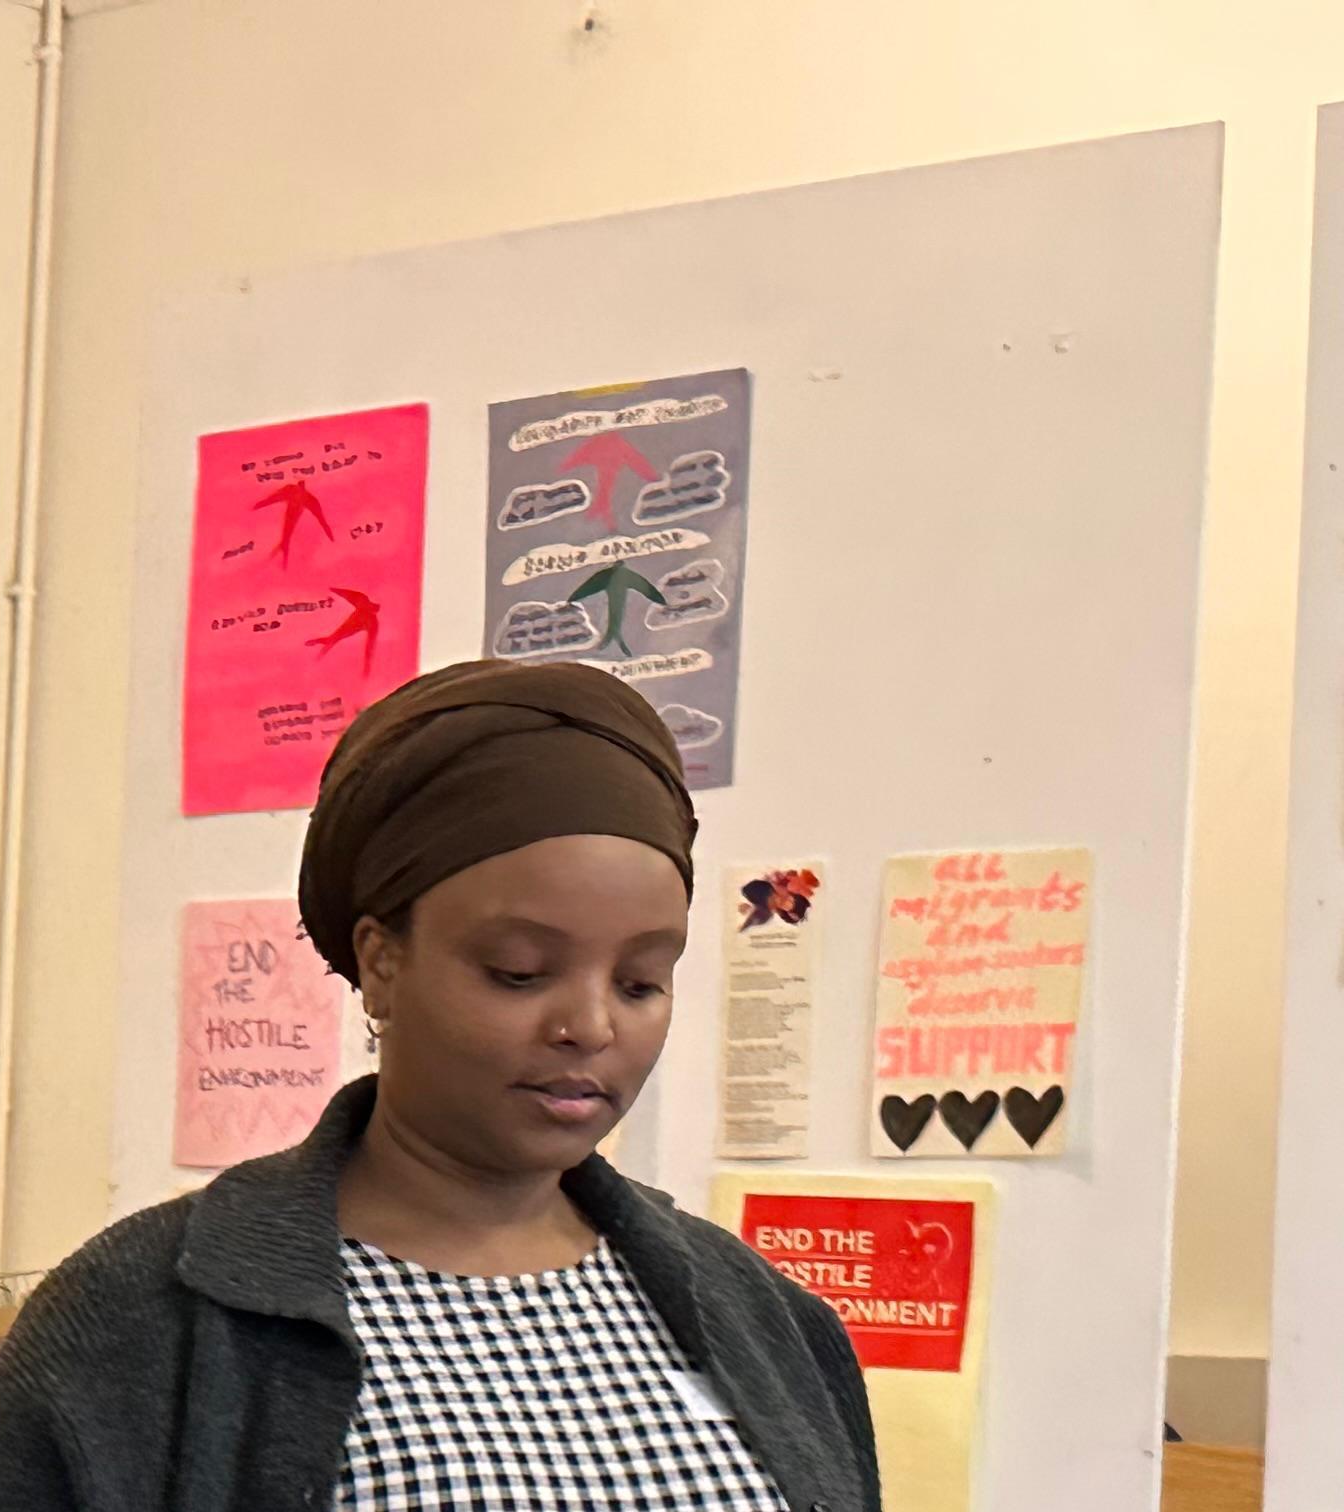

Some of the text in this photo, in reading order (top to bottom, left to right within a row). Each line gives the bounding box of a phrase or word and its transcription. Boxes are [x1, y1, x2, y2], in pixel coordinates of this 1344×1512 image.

[227, 939, 280, 975] END
[213, 978, 255, 1004] THE
[206, 1017, 310, 1052] HOSTILE
[876, 1023, 1077, 1079] SUPPORT
[755, 1226, 876, 1254] END THE
[775, 1260, 874, 1289] OSTILE
[821, 1296, 958, 1327] ONMENT
